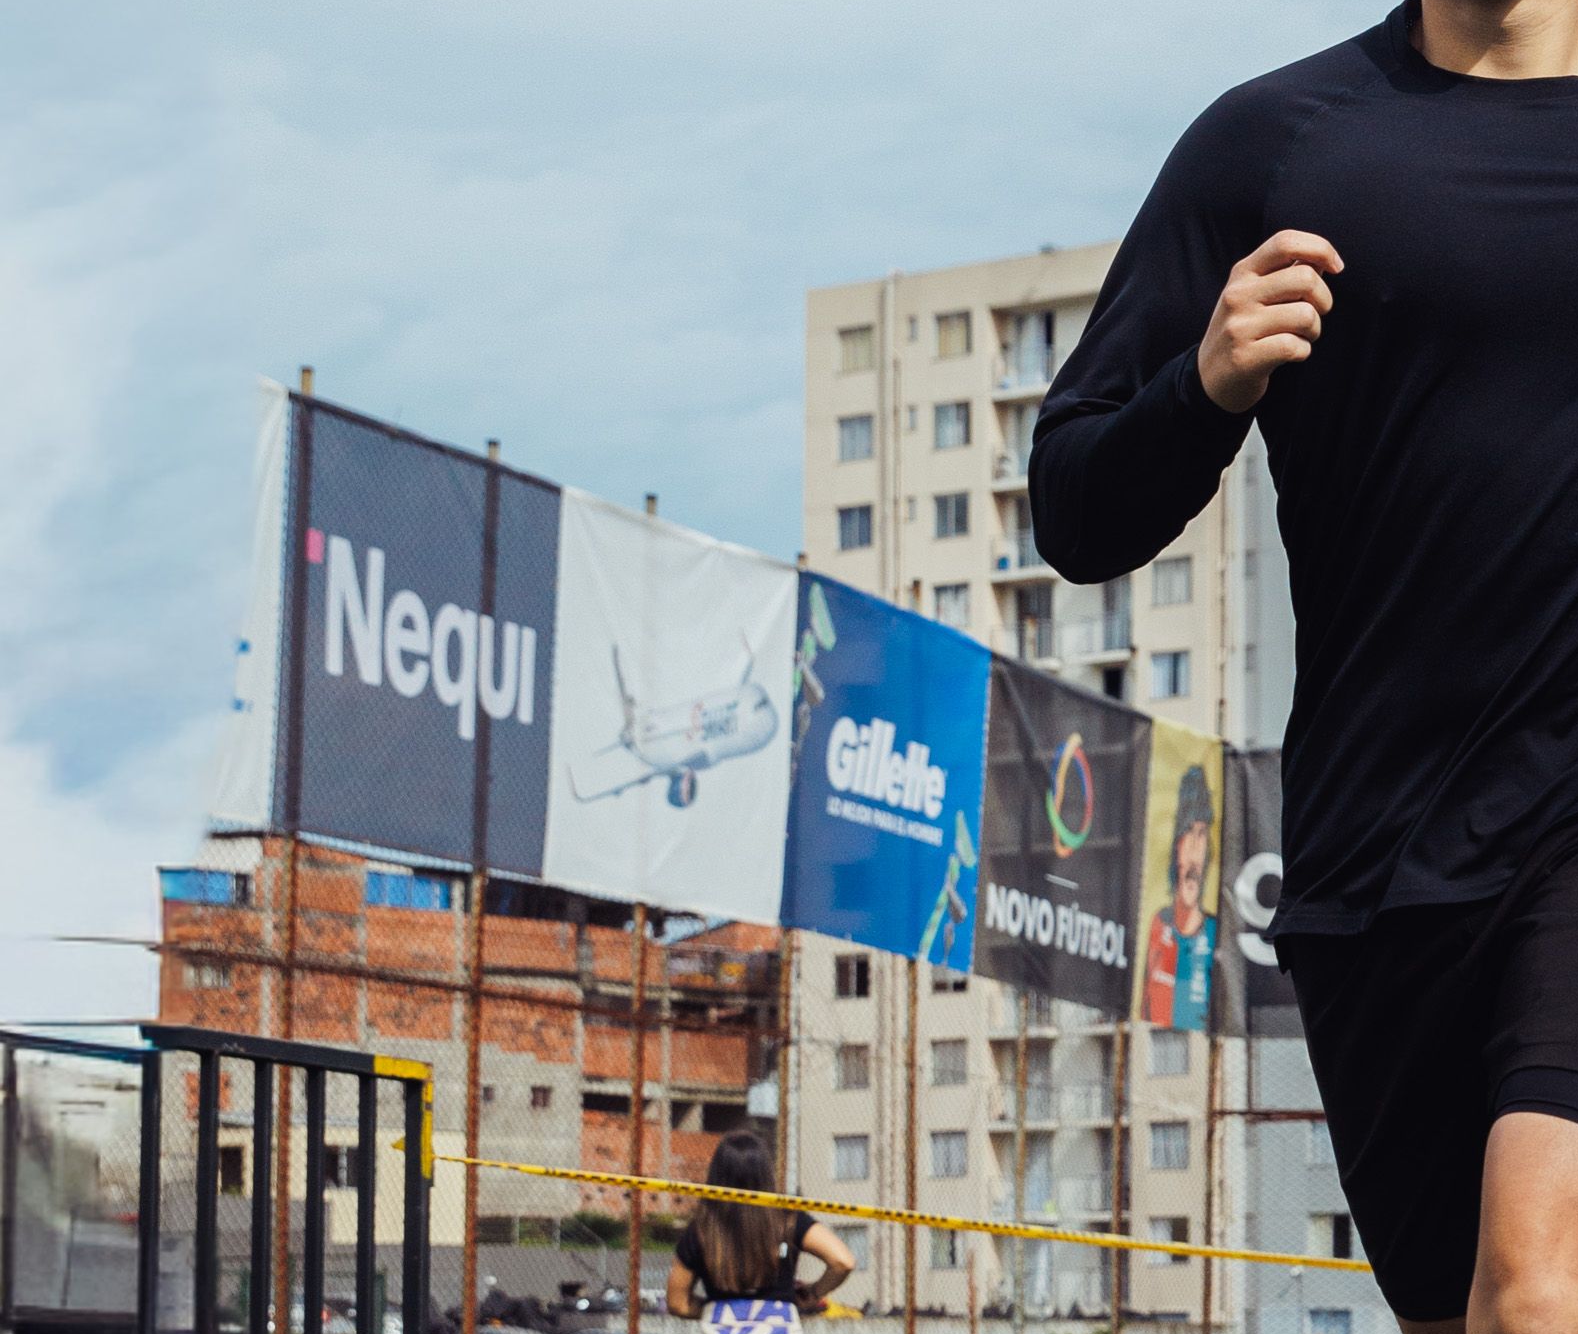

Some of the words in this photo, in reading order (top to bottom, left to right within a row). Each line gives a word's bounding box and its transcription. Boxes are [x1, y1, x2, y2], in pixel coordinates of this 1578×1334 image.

[326, 534, 537, 741] Nequi
[826, 717, 946, 819] Gillette
[985, 882, 1054, 946] NOVO
